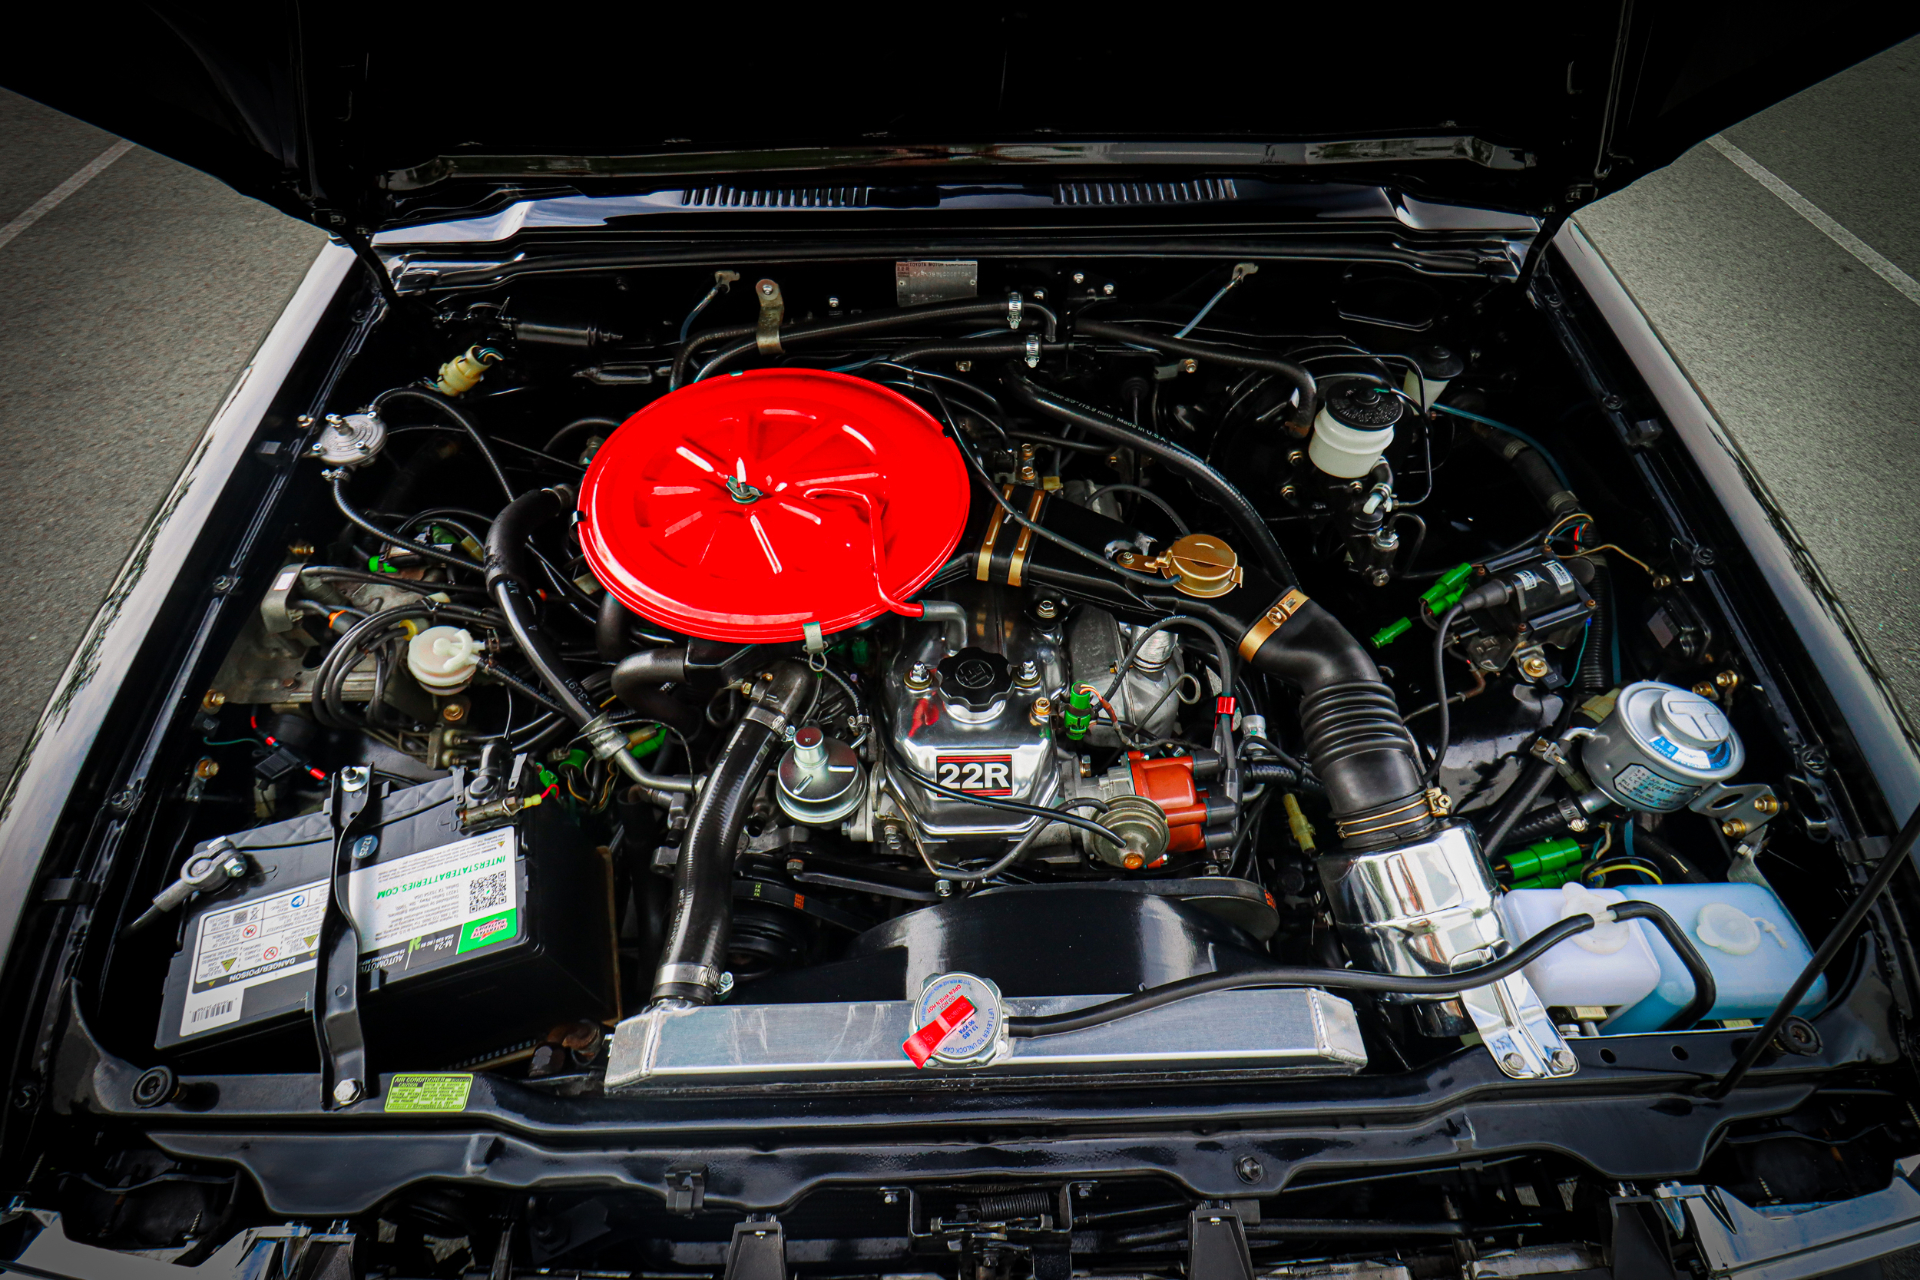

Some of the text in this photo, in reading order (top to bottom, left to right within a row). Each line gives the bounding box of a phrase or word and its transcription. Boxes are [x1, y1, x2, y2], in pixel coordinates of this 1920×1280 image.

[1116, 417, 1137, 429] Made
[1146, 429, 1168, 443] U.S.A.
[1651, 743, 1672, 757] NOTICE
[939, 763, 1010, 789] 22R
[358, 836, 372, 856] 12/25
[377, 854, 504, 900] INTERSTATEBATTERIES.COM
[434, 938, 452, 951] M-24
[229, 956, 294, 983] DANGER/POISON
[927, 984, 961, 1013] OPEN WHEN HOT
[940, 1001, 949, 1010] NOT
[958, 1025, 969, 1034] KPA
[962, 1029, 972, 1039] LBS
[983, 1020, 993, 1038] LEVER
[957, 1042, 977, 1053] UNLOCK
[977, 1036, 984, 1045] TO
